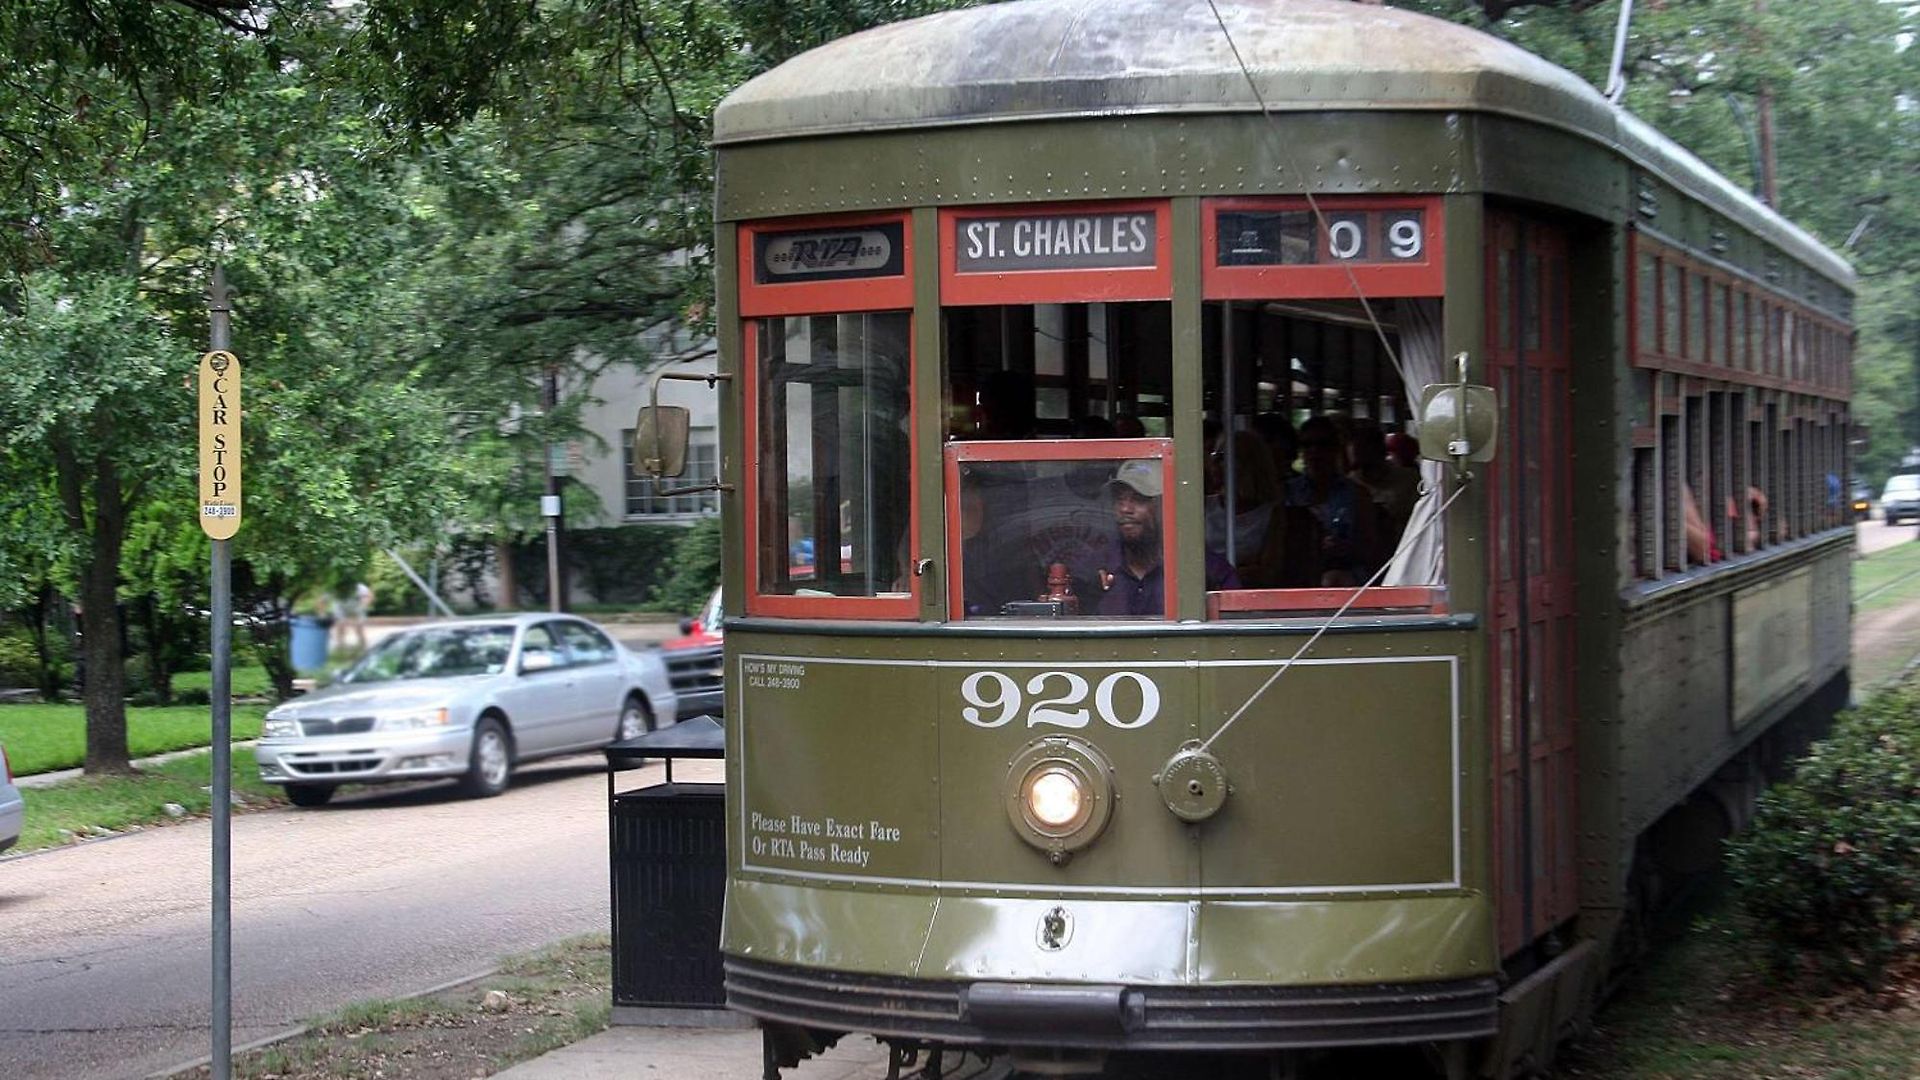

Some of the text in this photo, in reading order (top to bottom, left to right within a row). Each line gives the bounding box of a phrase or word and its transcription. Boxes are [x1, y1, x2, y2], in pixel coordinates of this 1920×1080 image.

[967, 216, 1147, 259] ST. CHARLES
[212, 378, 228, 425] CAR
[212, 433, 228, 497] STOP
[749, 675, 765, 687] CALL
[961, 671, 1161, 729] 920
[752, 812, 900, 842] Please Have Exact Fare
[752, 836, 870, 868] Or RTA Pass Ready
